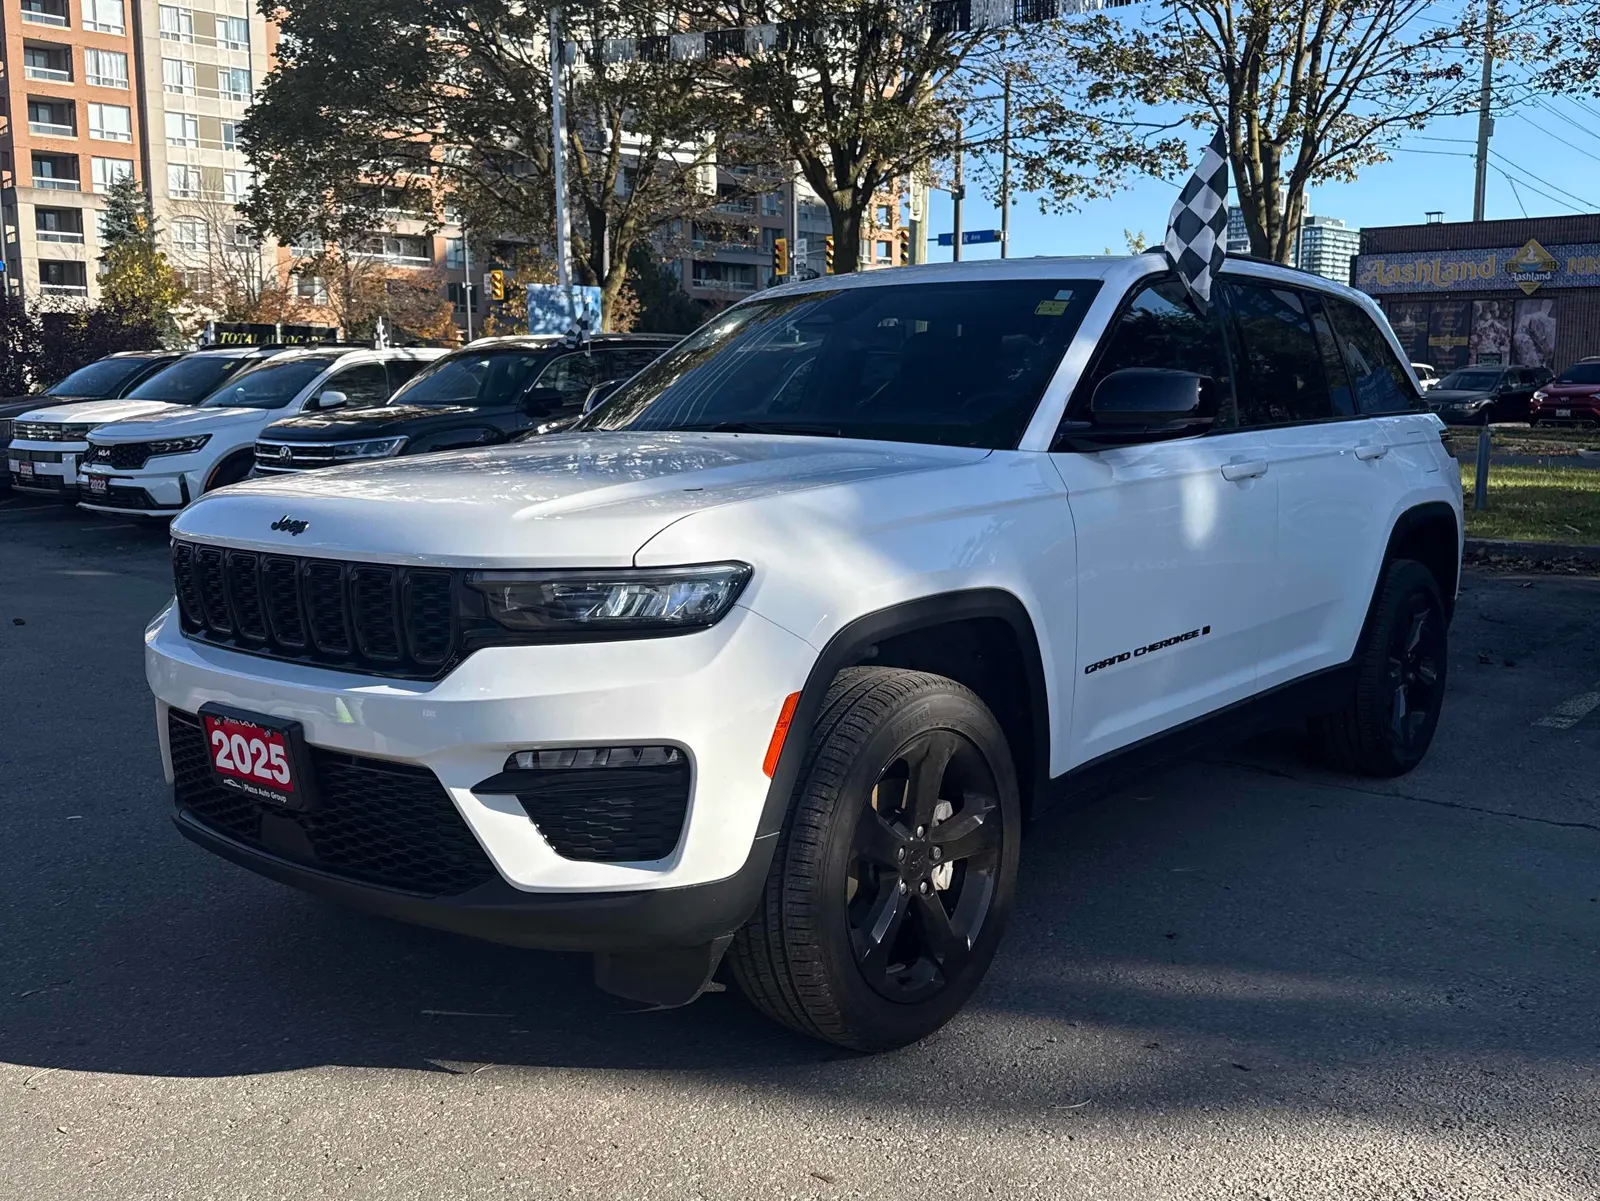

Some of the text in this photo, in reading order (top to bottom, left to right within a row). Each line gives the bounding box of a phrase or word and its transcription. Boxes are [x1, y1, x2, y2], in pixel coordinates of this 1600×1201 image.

[1358, 255, 1496, 287] Aashland
[220, 332, 260, 345] TOTAL
[90, 479, 106, 490] 2022
[271, 515, 309, 537] Jeep
[1084, 629, 1200, 674] GRAND CHEROKEE
[212, 730, 291, 785] 2025
[243, 783, 287, 804] Plaza Auto Group
